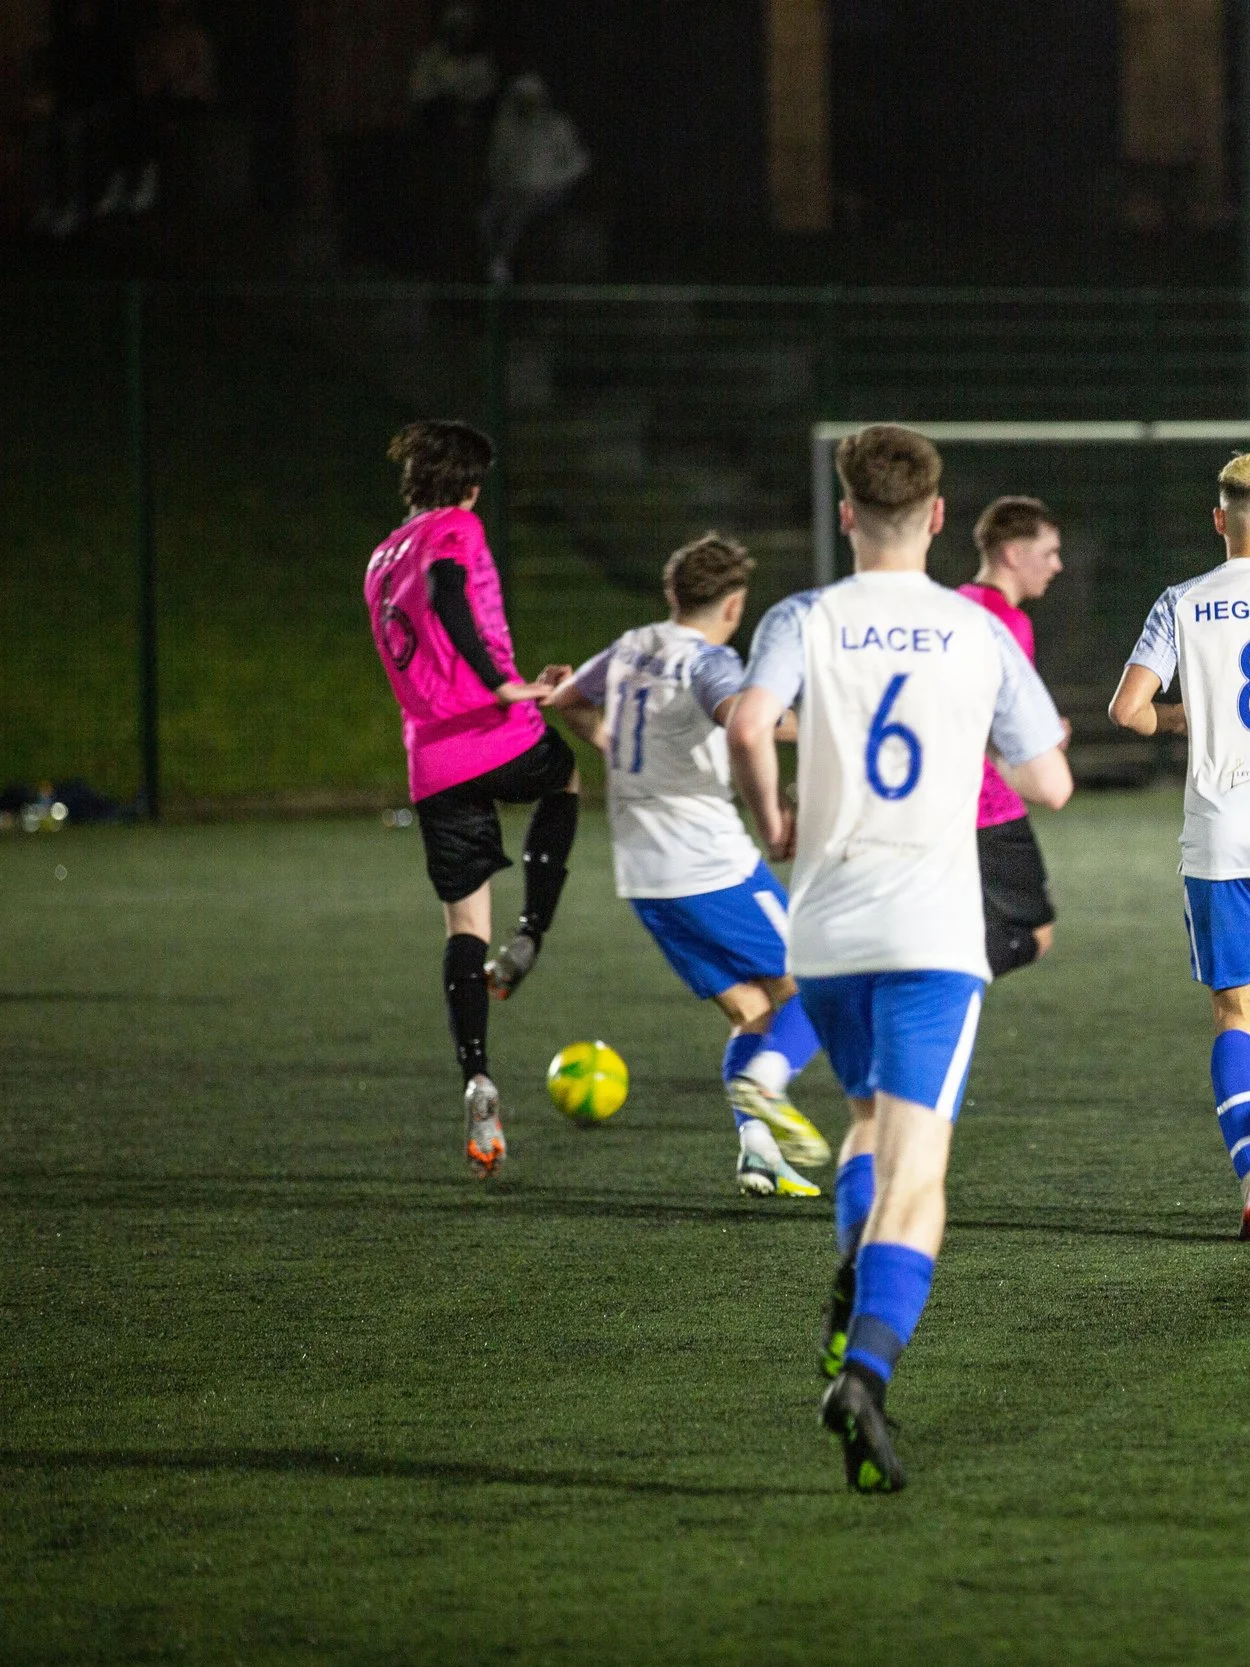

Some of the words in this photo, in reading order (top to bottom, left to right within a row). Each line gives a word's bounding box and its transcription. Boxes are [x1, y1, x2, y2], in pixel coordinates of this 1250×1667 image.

[841, 626, 954, 653] LACEY
[611, 680, 650, 775] 11
[865, 672, 923, 801] 6
